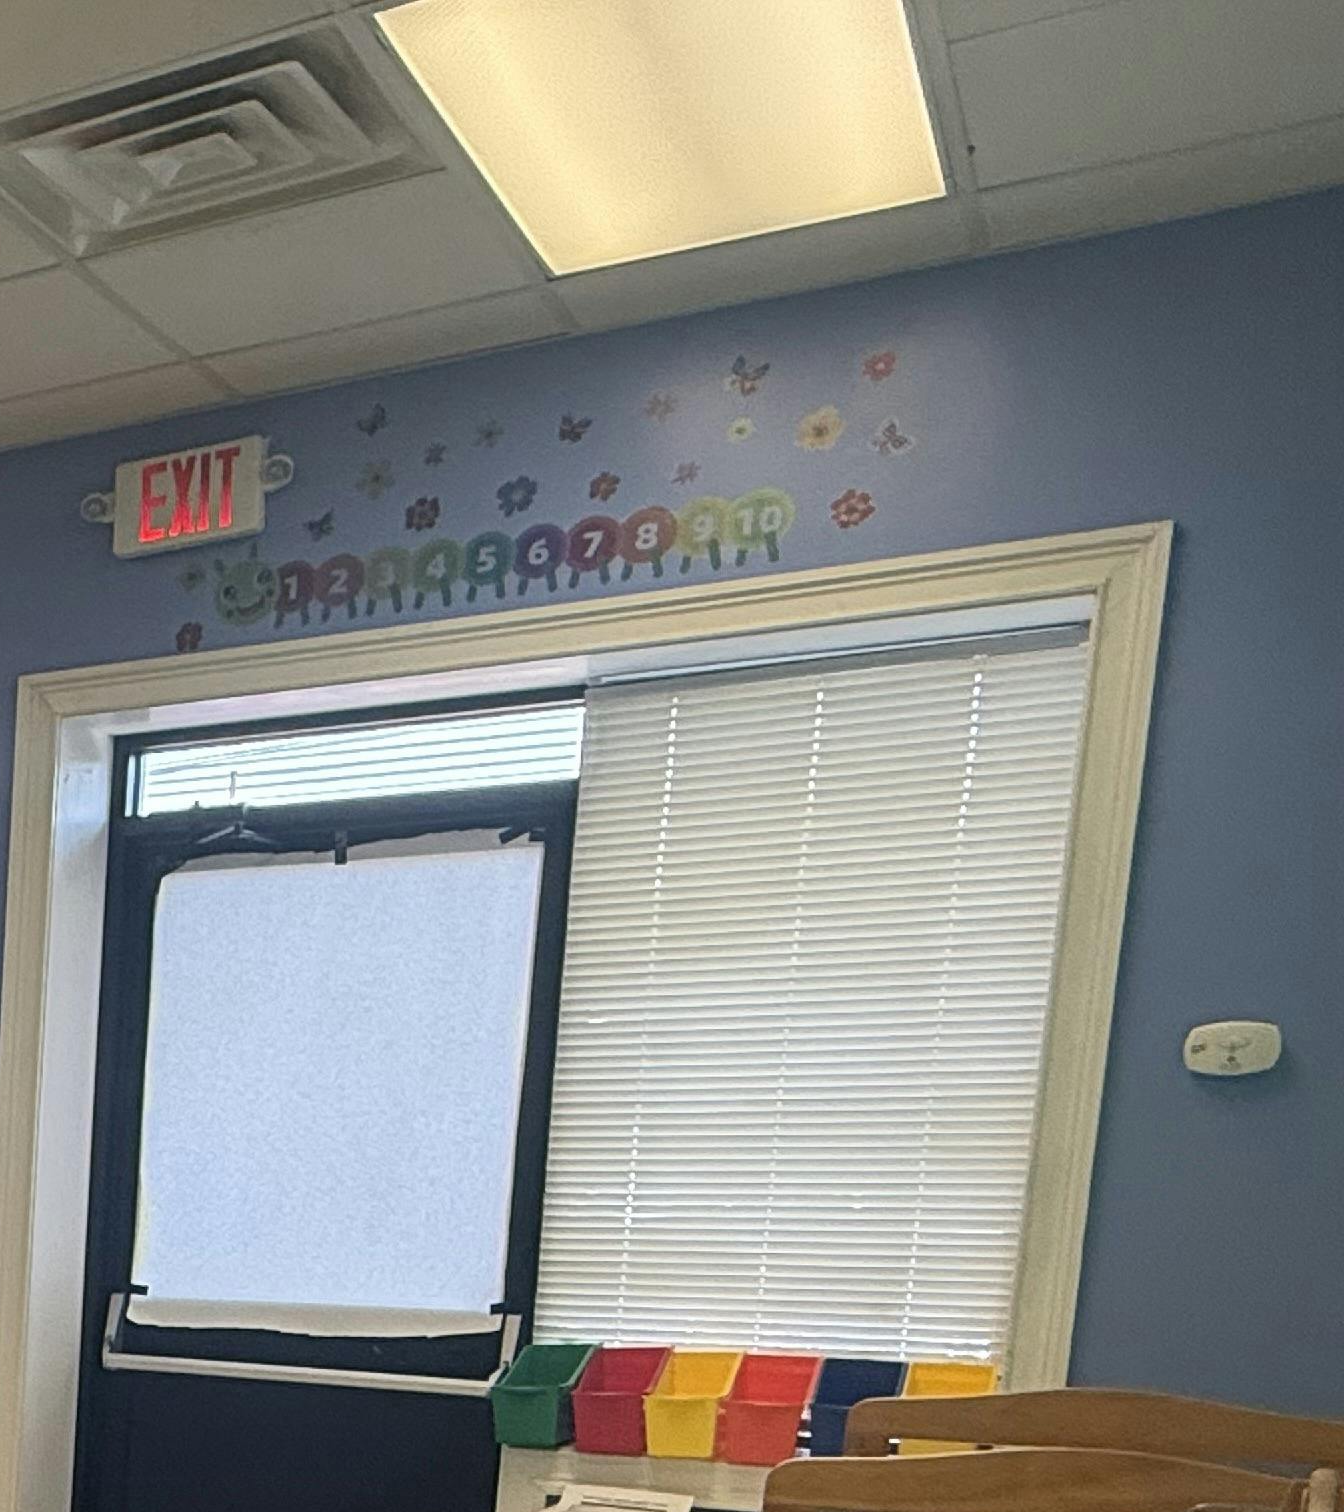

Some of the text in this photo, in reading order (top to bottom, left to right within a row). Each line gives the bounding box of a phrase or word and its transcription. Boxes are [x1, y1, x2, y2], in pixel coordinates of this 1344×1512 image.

[138, 445, 241, 544] EXIT
[284, 506, 784, 600] 1 2 3 4 5 6 7 8 9 10
